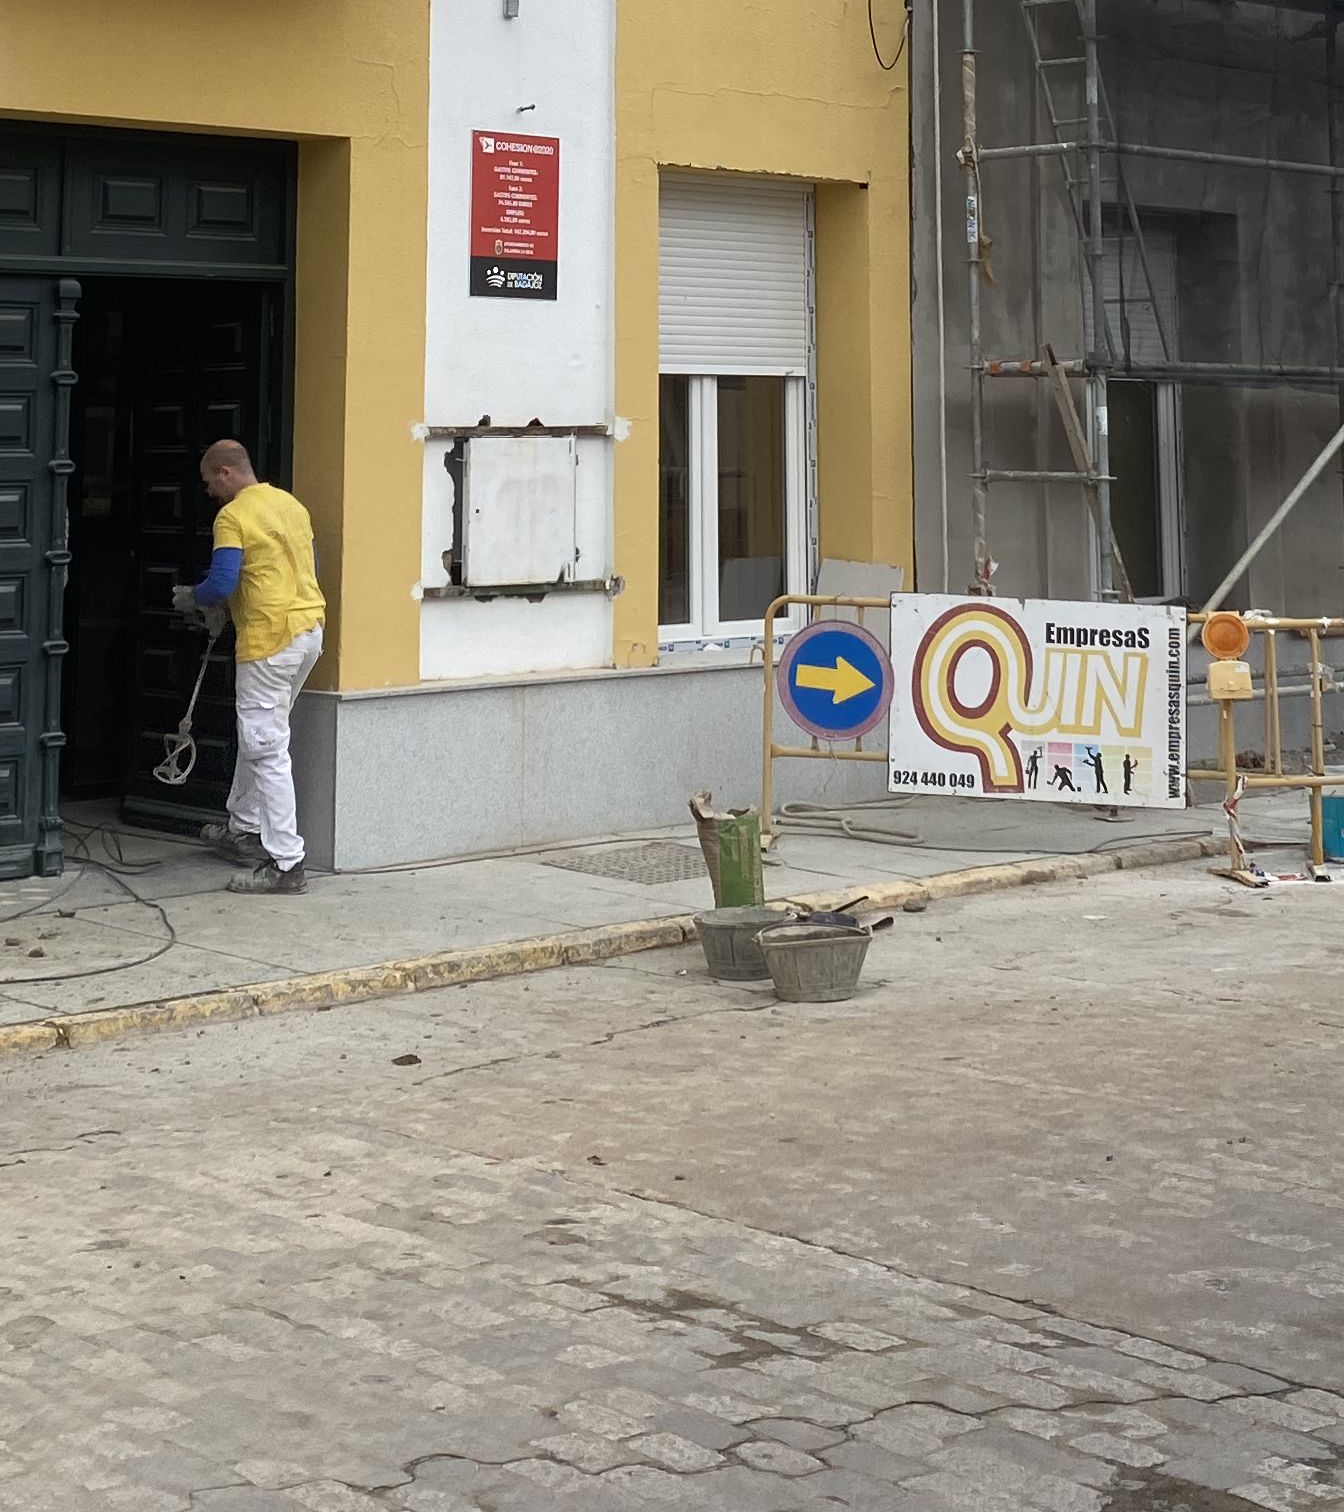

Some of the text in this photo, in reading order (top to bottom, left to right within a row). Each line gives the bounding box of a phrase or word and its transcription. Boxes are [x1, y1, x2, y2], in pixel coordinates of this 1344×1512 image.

[1046, 623, 1149, 648] EmpresaS
[912, 602, 1149, 793] QUIN
[1166, 628, 1182, 798] www.empresasquin.com
[894, 771, 974, 788] 924 440 049
